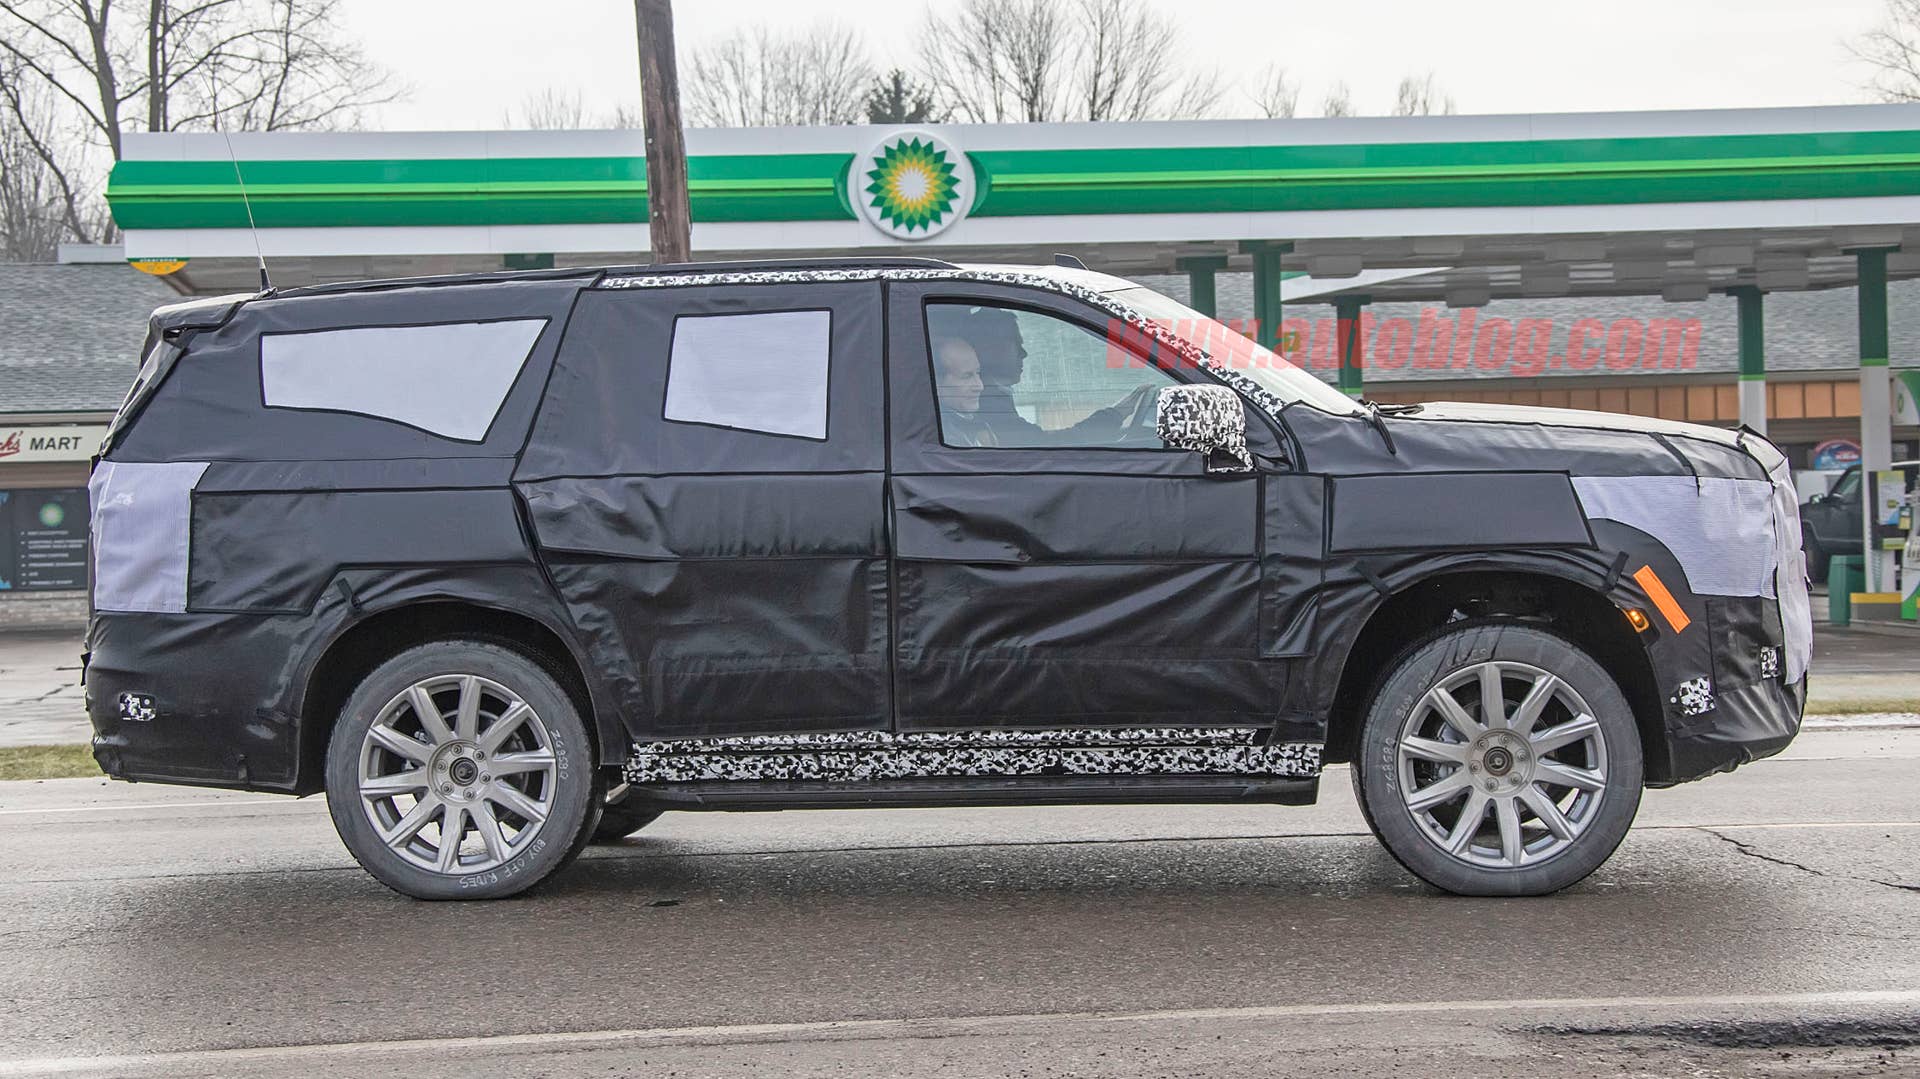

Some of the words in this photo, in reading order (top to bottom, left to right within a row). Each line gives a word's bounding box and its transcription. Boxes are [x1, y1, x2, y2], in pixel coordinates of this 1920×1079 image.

[30, 436, 83, 450] MART
[528, 839, 546, 860] BUY
[504, 858, 525, 878] OFF
[459, 872, 498, 889] RIDES
